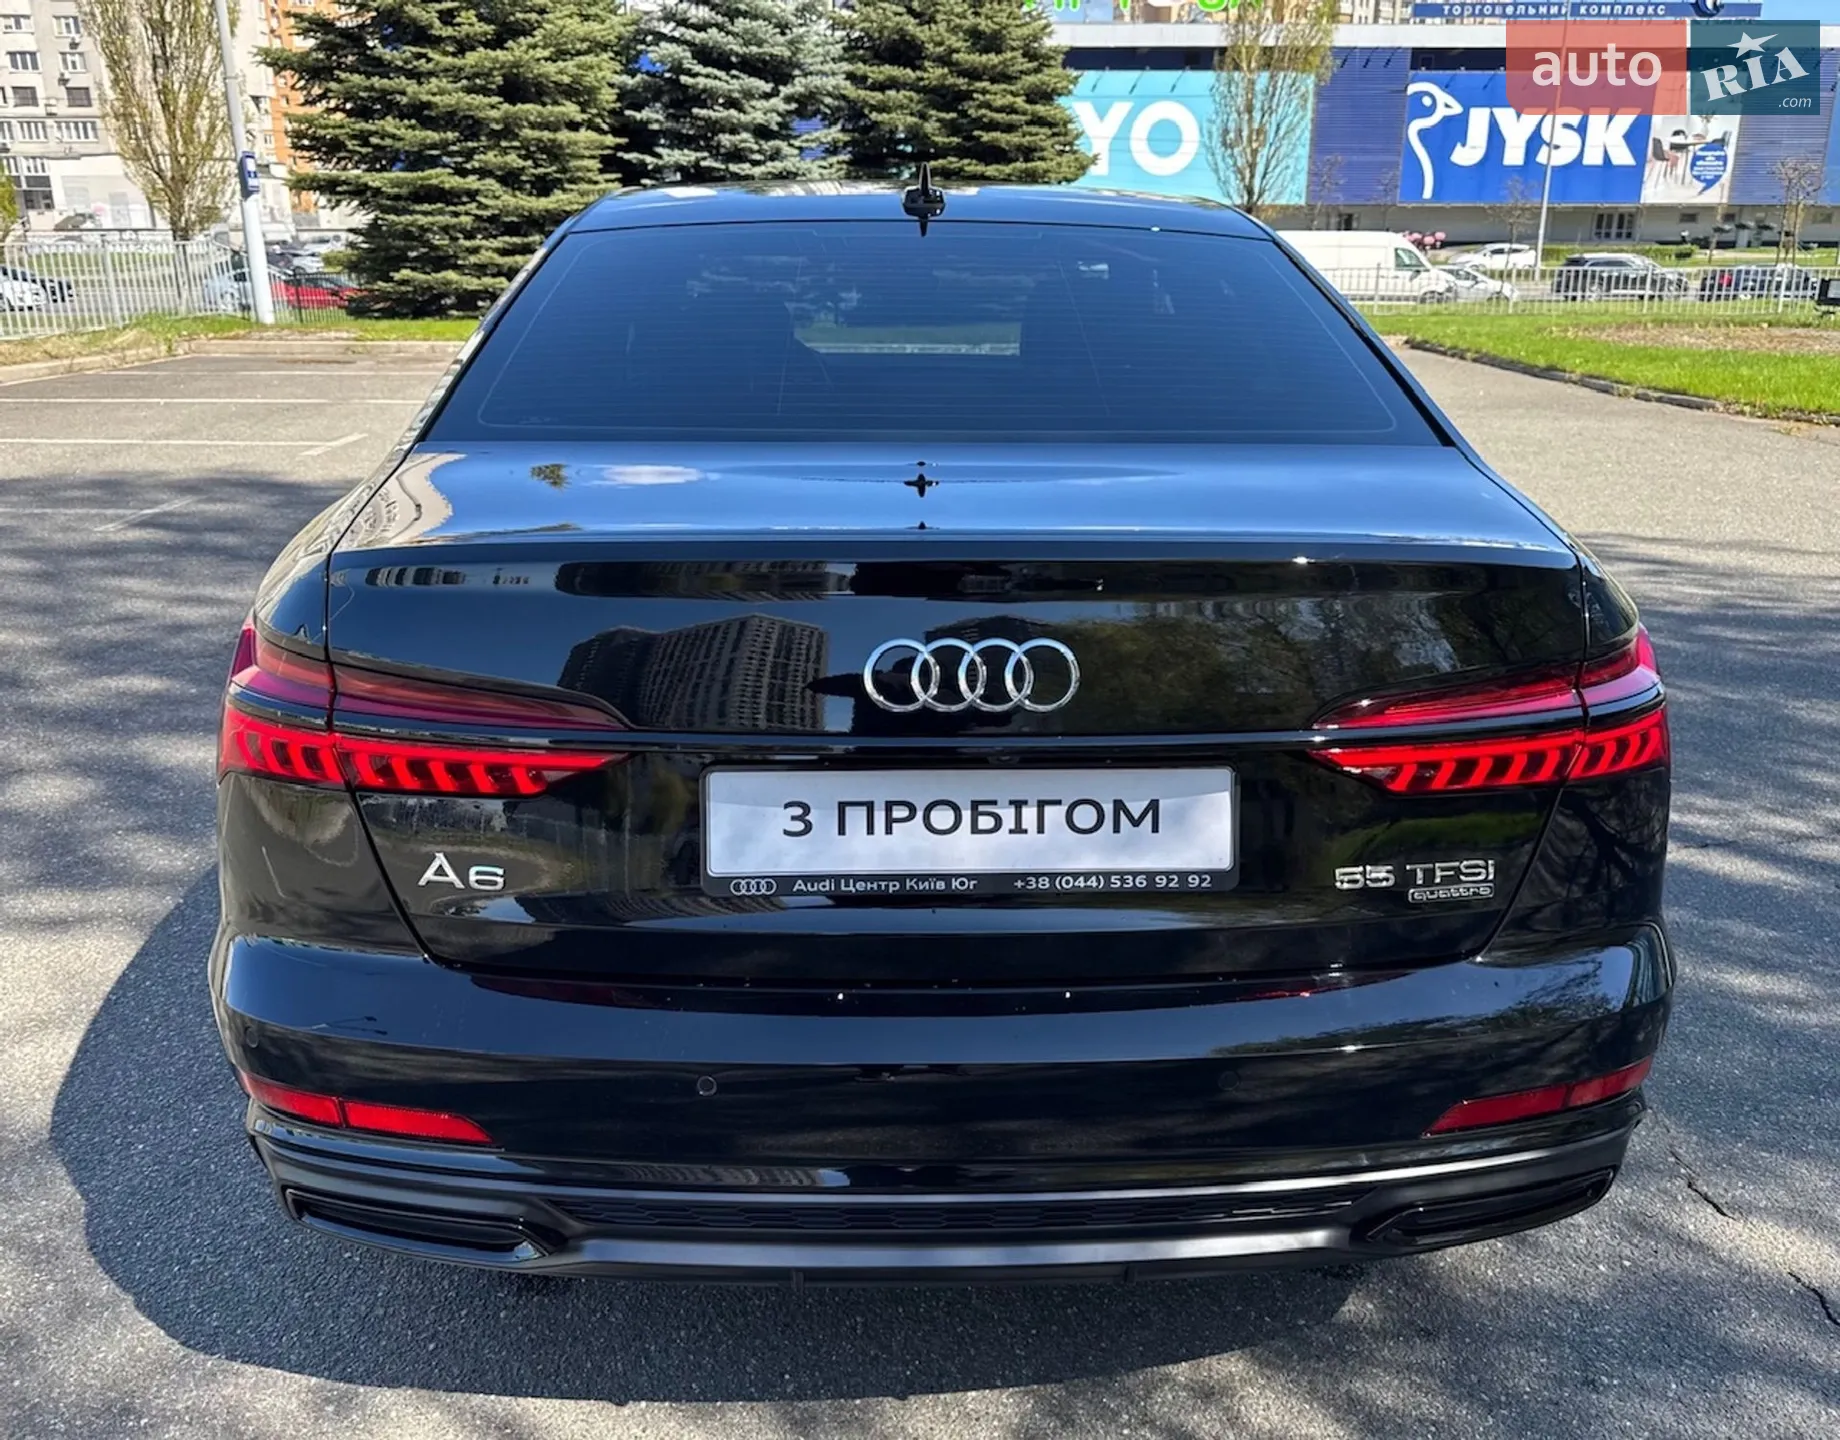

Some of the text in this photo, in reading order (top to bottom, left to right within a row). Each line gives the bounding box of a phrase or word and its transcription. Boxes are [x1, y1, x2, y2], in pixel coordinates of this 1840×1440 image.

[1579, 4, 1666, 15] комплекс
[1450, 107, 1642, 167] JYSK
[837, 798, 1160, 837] ПРОБІГОМ
[418, 852, 504, 891] A6
[1014, 874, 1212, 890] +38 (044) 536 92 92
[1335, 860, 1495, 890] 55 TFSI
[792, 877, 978, 893] Audi Центр Київ Юг
[1413, 886, 1493, 901] quattro
